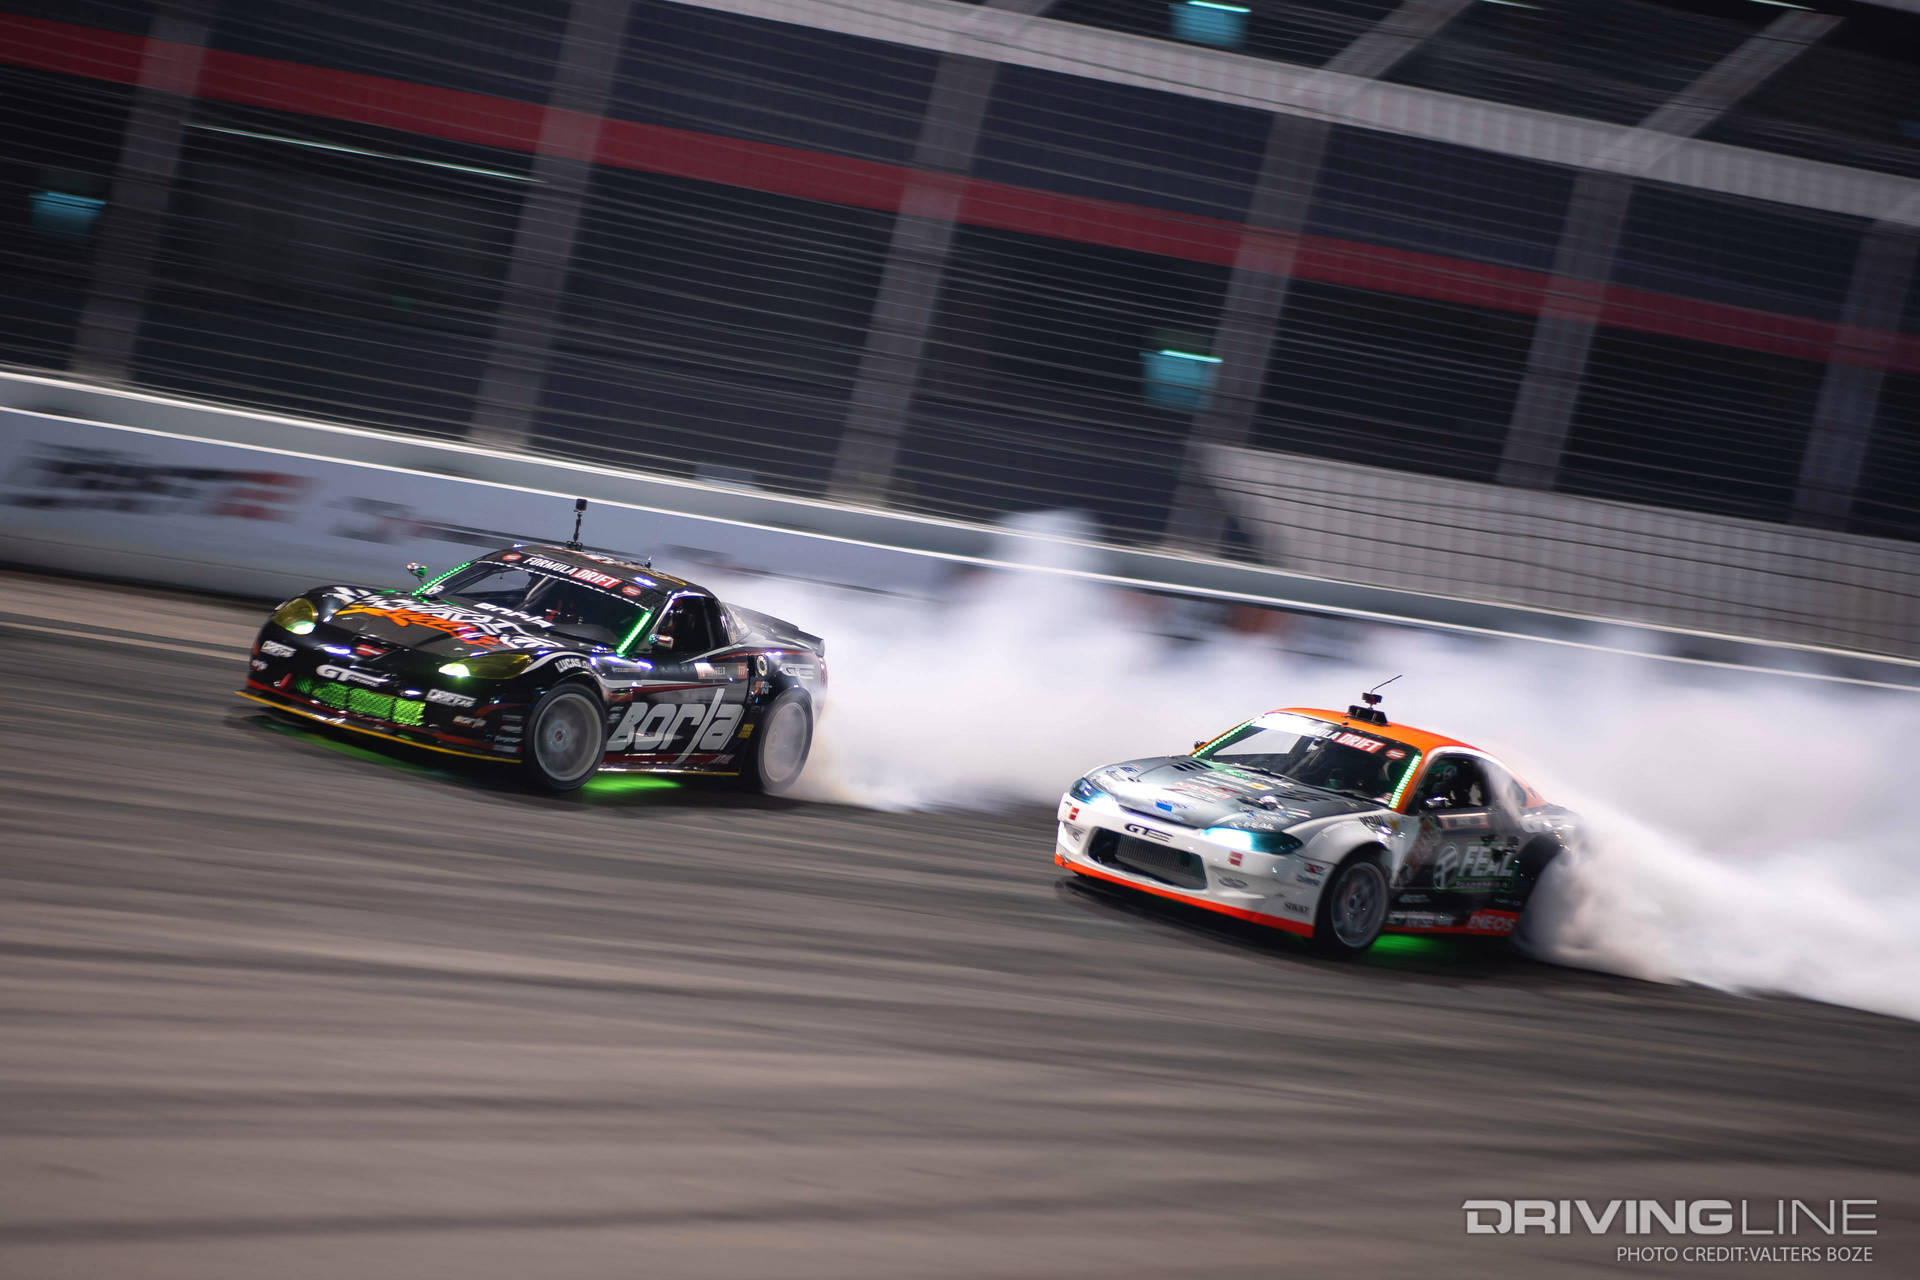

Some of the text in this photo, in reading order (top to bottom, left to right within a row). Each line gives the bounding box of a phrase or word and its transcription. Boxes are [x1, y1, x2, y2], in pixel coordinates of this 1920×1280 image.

[522, 557, 578, 576] FORMULA
[574, 568, 620, 588] DRIFT
[554, 658, 580, 673] LUCAS
[1336, 734, 1381, 753] DRIFT
[1467, 914, 1518, 932] ENEOS
